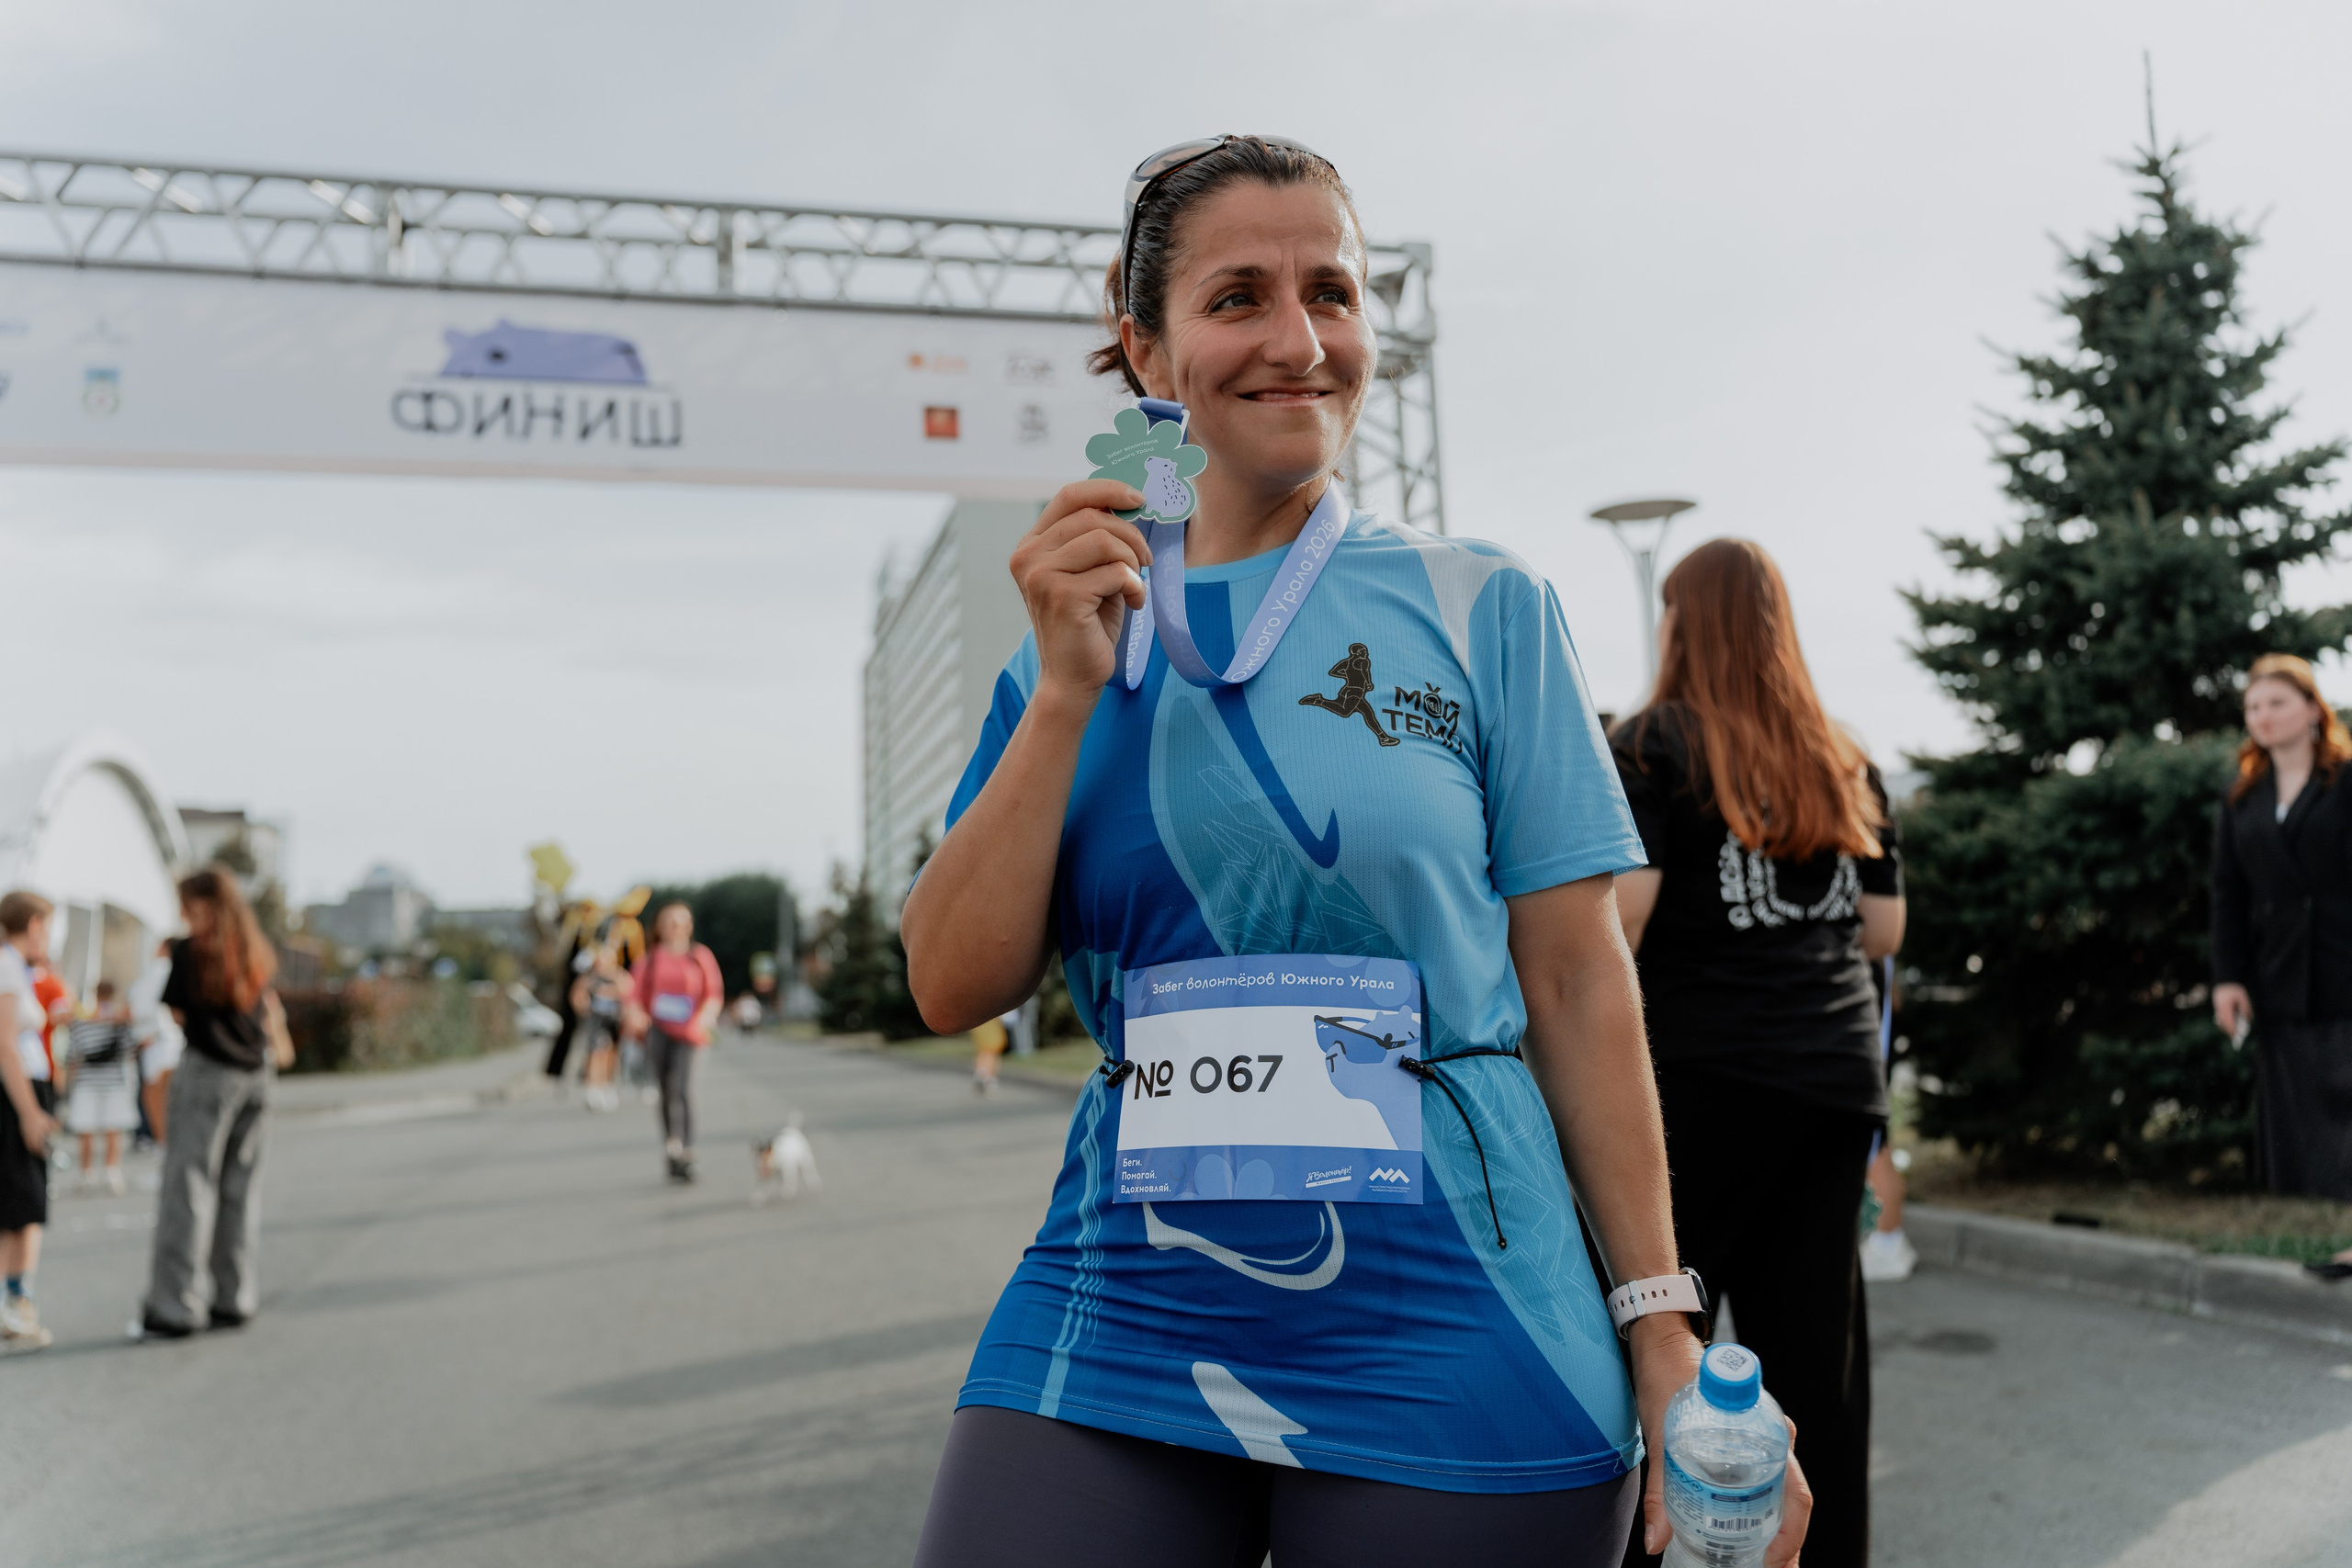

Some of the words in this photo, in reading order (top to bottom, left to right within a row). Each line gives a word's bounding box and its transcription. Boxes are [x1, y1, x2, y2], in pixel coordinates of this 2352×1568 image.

[390, 387, 684, 448] ФИНИШ
[1105, 448, 1123, 459] Забег
[1111, 452, 1136, 465] Южного
[1136, 446, 1155, 455] Урала
[1228, 617, 1281, 682] Южного
[1272, 559, 1314, 613] Урала
[1305, 519, 1336, 559] 2026
[1395, 682, 1461, 733] МОЙ
[1152, 982, 1183, 995] Забег
[1185, 972, 1275, 991] волонтёров
[1281, 973, 1345, 987] Южного
[1350, 975, 1395, 991] Урала
[1190, 1055, 1283, 1094] 067
[1122, 1157, 1143, 1168] Беги.
[1121, 1169, 1158, 1181] Помогай.
[1120, 1182, 1171, 1195] Вдохновляй.
